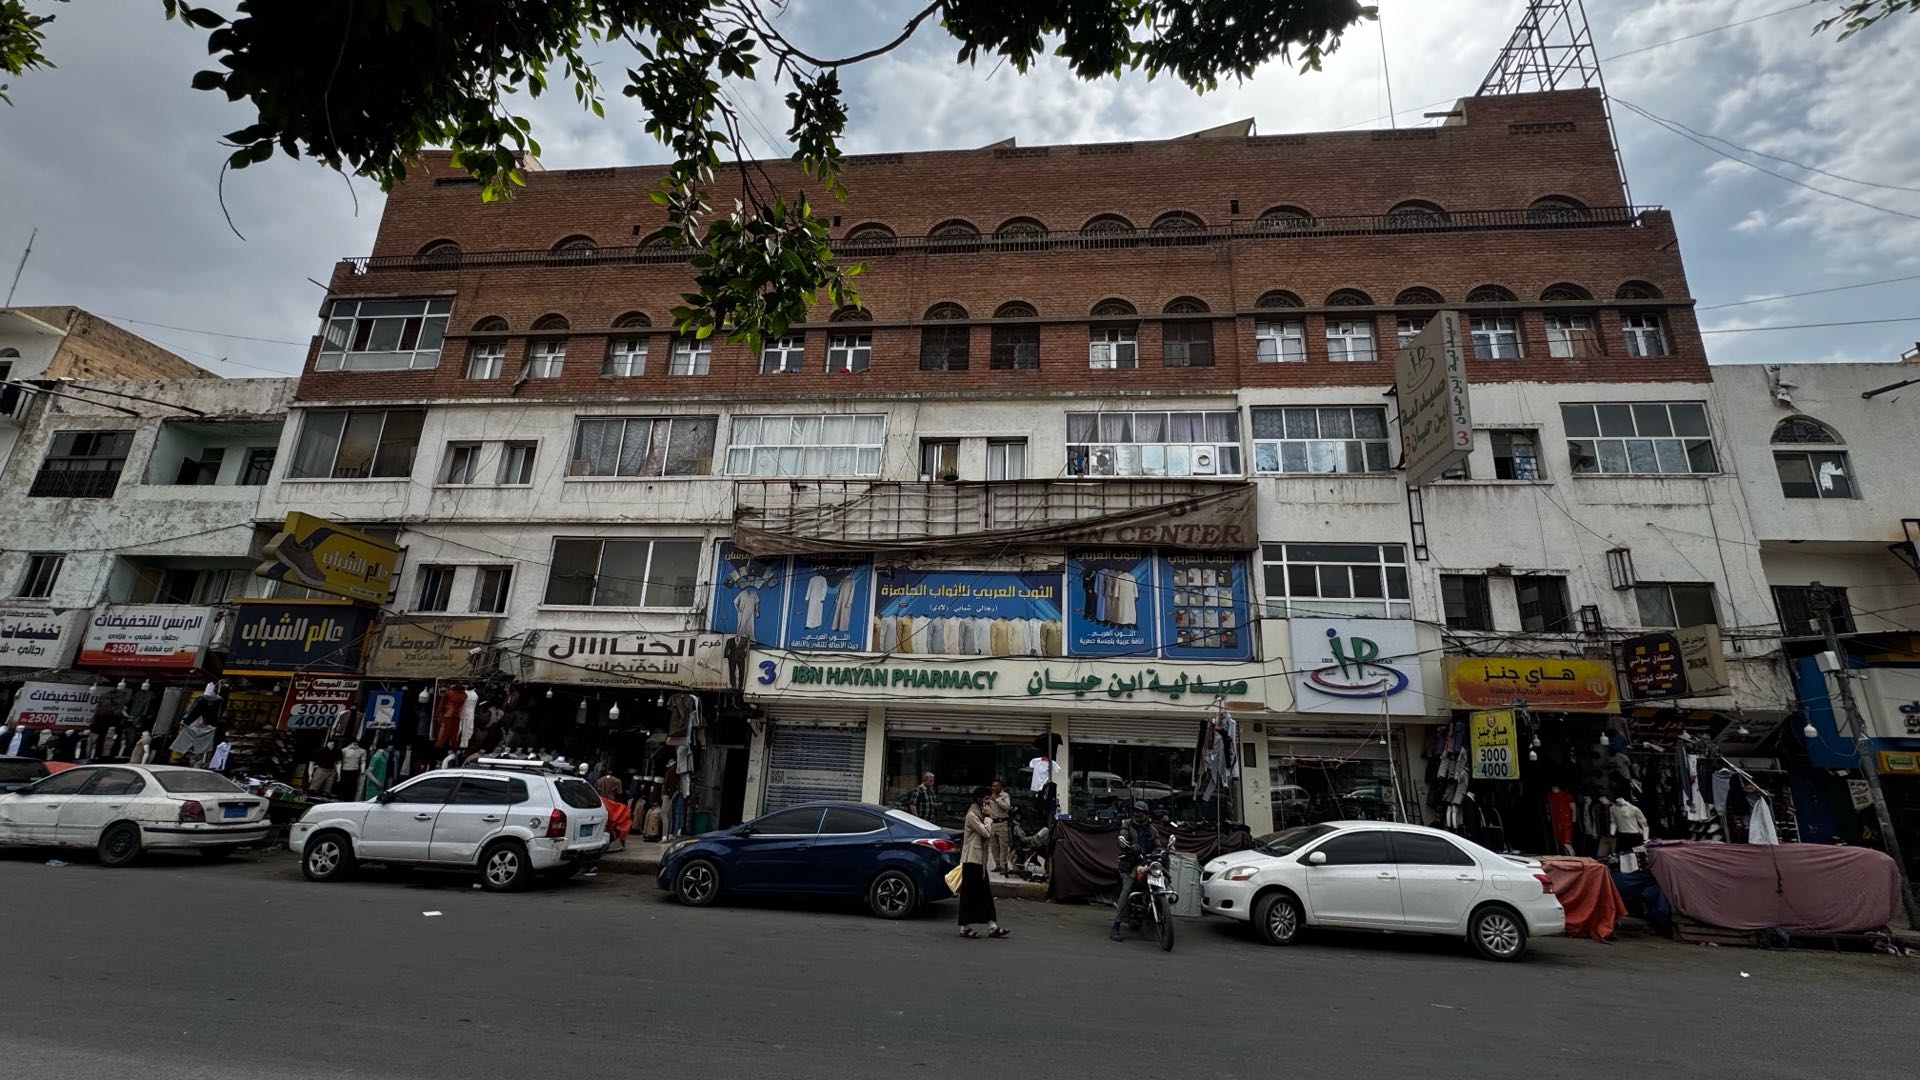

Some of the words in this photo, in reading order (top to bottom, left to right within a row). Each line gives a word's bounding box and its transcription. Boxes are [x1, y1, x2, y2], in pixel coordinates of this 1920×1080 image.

[1400, 377, 1446, 427] صيدلية
[1456, 431, 1469, 446] 3
[1115, 524, 1244, 545] CENTER
[880, 583, 927, 598] الجاهزة
[973, 585, 1016, 599] العربي
[1018, 585, 1053, 599] الثوب
[94, 614, 162, 630] للتخفيضات
[162, 615, 203, 631] البرنس
[241, 612, 309, 648] الشباب
[304, 618, 345, 653] عالم
[111, 643, 137, 654] 2500
[757, 660, 777, 685] 3
[791, 665, 824, 684] IBN
[826, 667, 888, 687] HAYAN
[891, 669, 998, 690] PHARMACY
[1027, 668, 1102, 697] حيان
[1483, 665, 1521, 684] جنز
[1524, 666, 1576, 688] هاي
[1107, 670, 1143, 698] ابن
[1149, 668, 1248, 699] صيدلية
[298, 704, 339, 715] 3000
[28, 714, 56, 724] 2500
[295, 715, 337, 728] 4000
[1480, 748, 1507, 762] 3000
[1481, 762, 1508, 776] 4000
